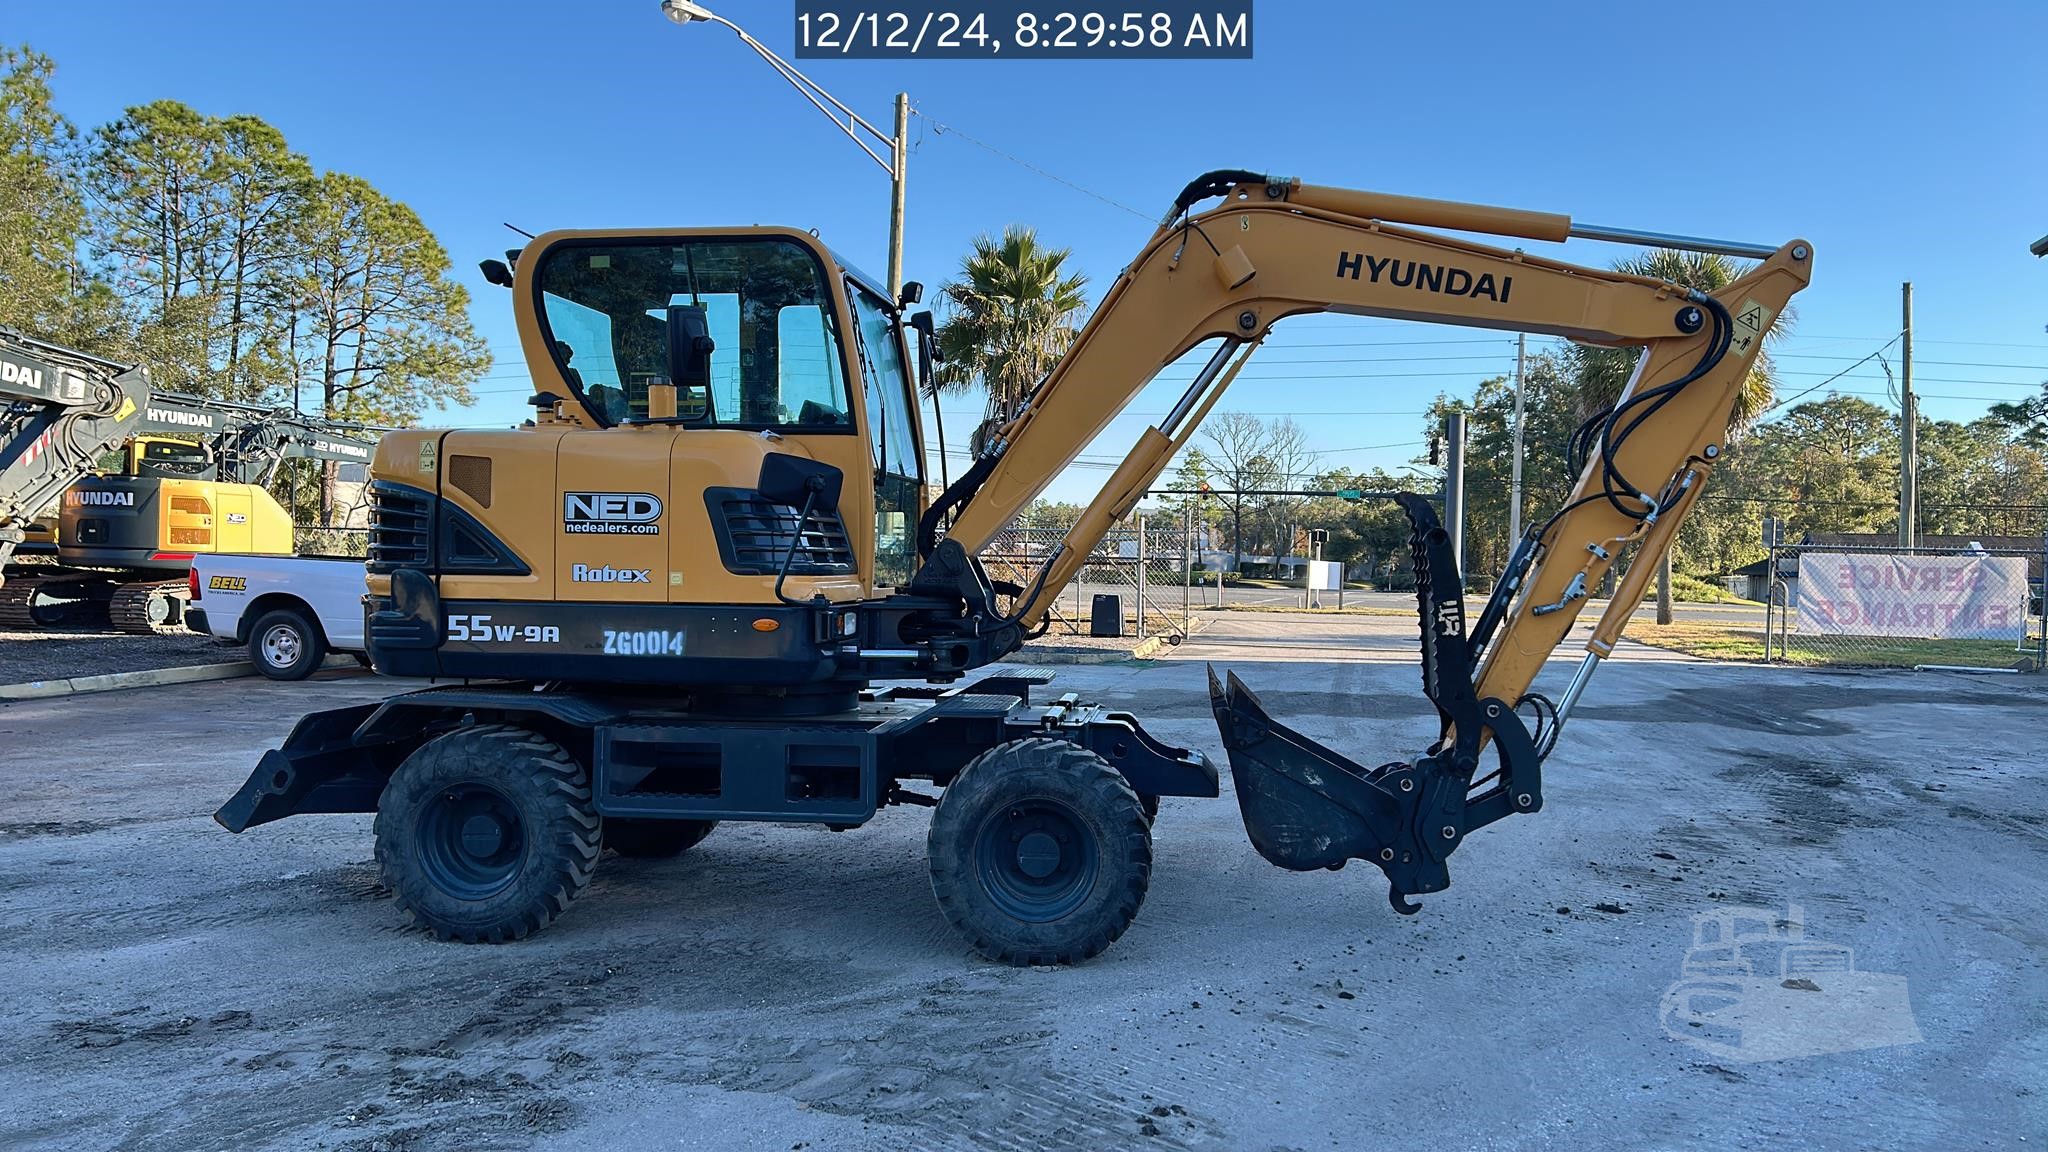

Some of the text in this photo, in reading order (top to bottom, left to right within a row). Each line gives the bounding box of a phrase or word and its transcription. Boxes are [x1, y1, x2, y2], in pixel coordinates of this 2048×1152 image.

[1336, 251, 1513, 304] HYUNDAI
[0, 360, 42, 390] DAI
[146, 408, 213, 428] HYUNDAI
[329, 442, 368, 458] HYUNDAI
[65, 490, 134, 506] HYUNDAI
[565, 493, 661, 521] NED
[565, 522, 658, 534] nedealers.com
[572, 563, 652, 583] Robex
[209, 576, 247, 591] BELL
[603, 630, 684, 656] ZG0014
